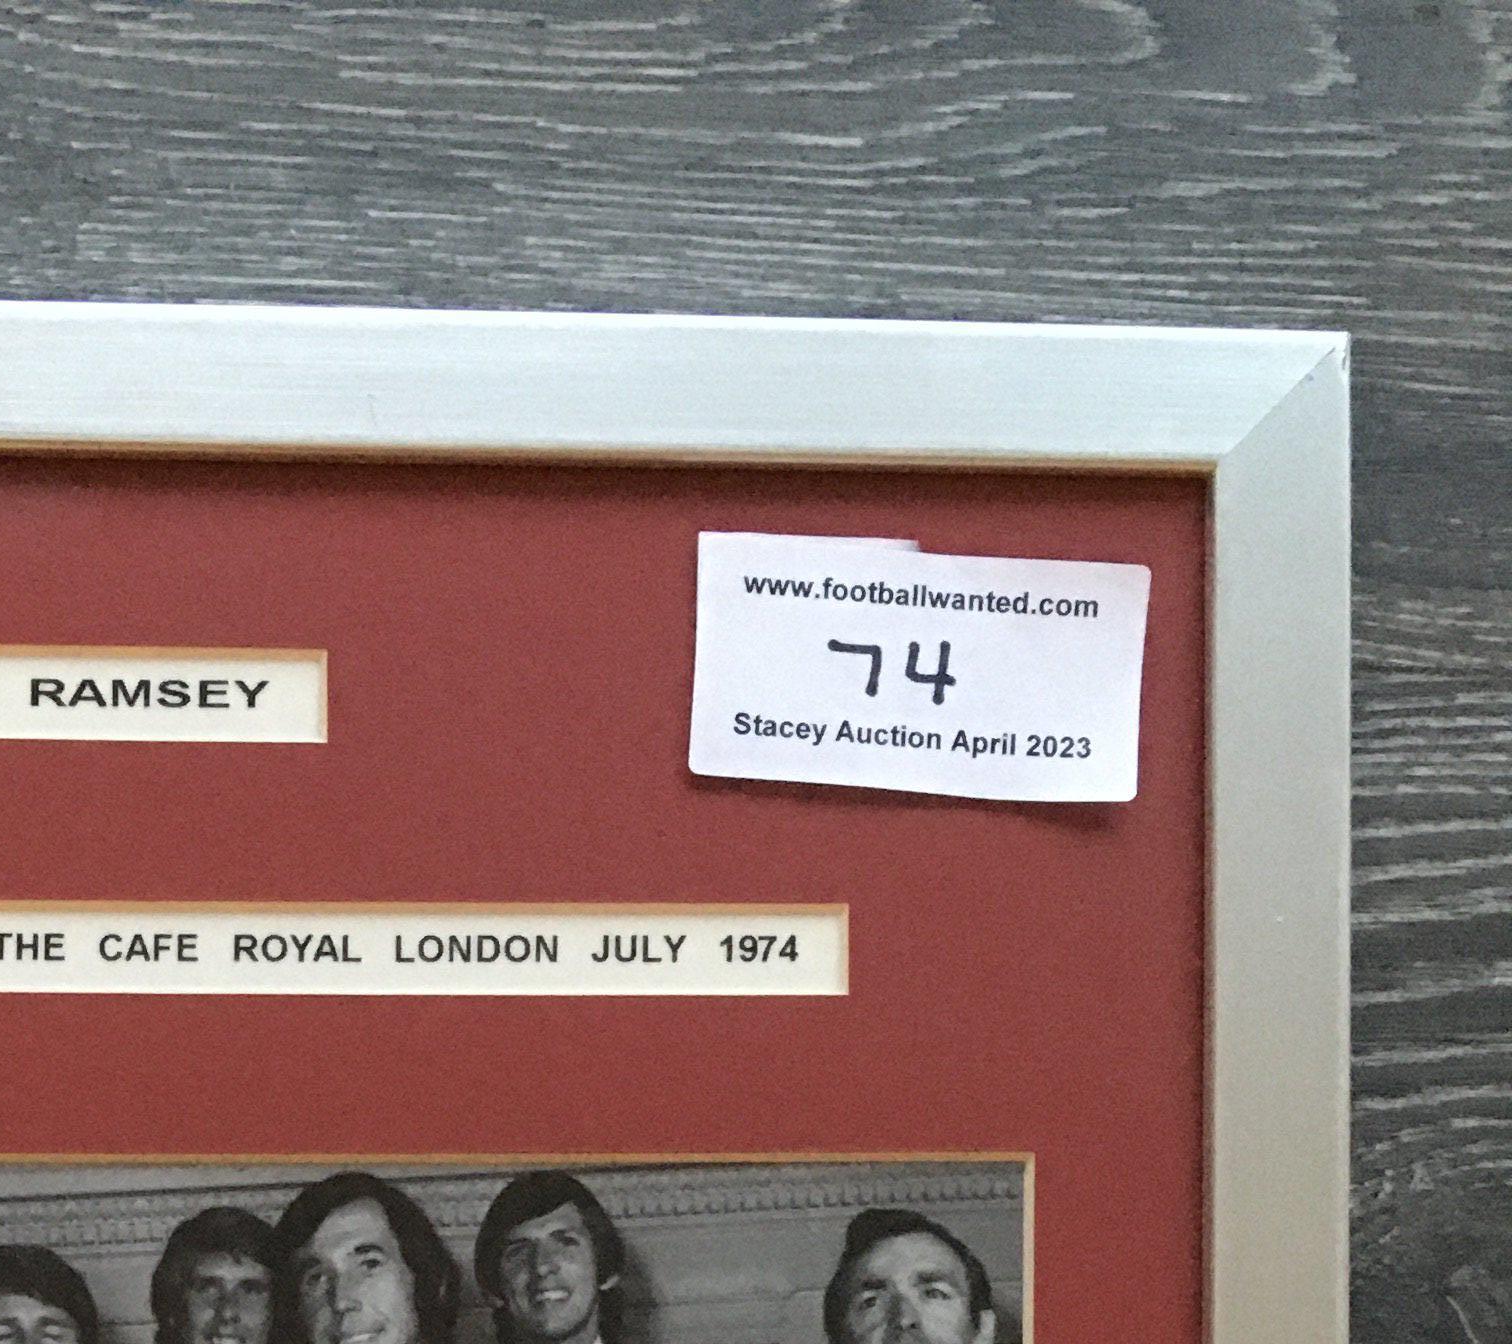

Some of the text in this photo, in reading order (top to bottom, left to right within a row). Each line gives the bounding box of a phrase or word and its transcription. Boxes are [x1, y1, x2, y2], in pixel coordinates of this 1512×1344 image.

[743, 575, 1100, 619] www.footballwanted.com
[29, 677, 270, 709] RAMSEY
[827, 638, 957, 706] 74
[732, 711, 1092, 760] Stacey Auction April 2023
[98, 932, 199, 963] CAFE
[233, 933, 363, 964] ROYAL
[394, 933, 559, 964] LONDON
[590, 934, 688, 964] JULY
[719, 933, 800, 964] 1974
